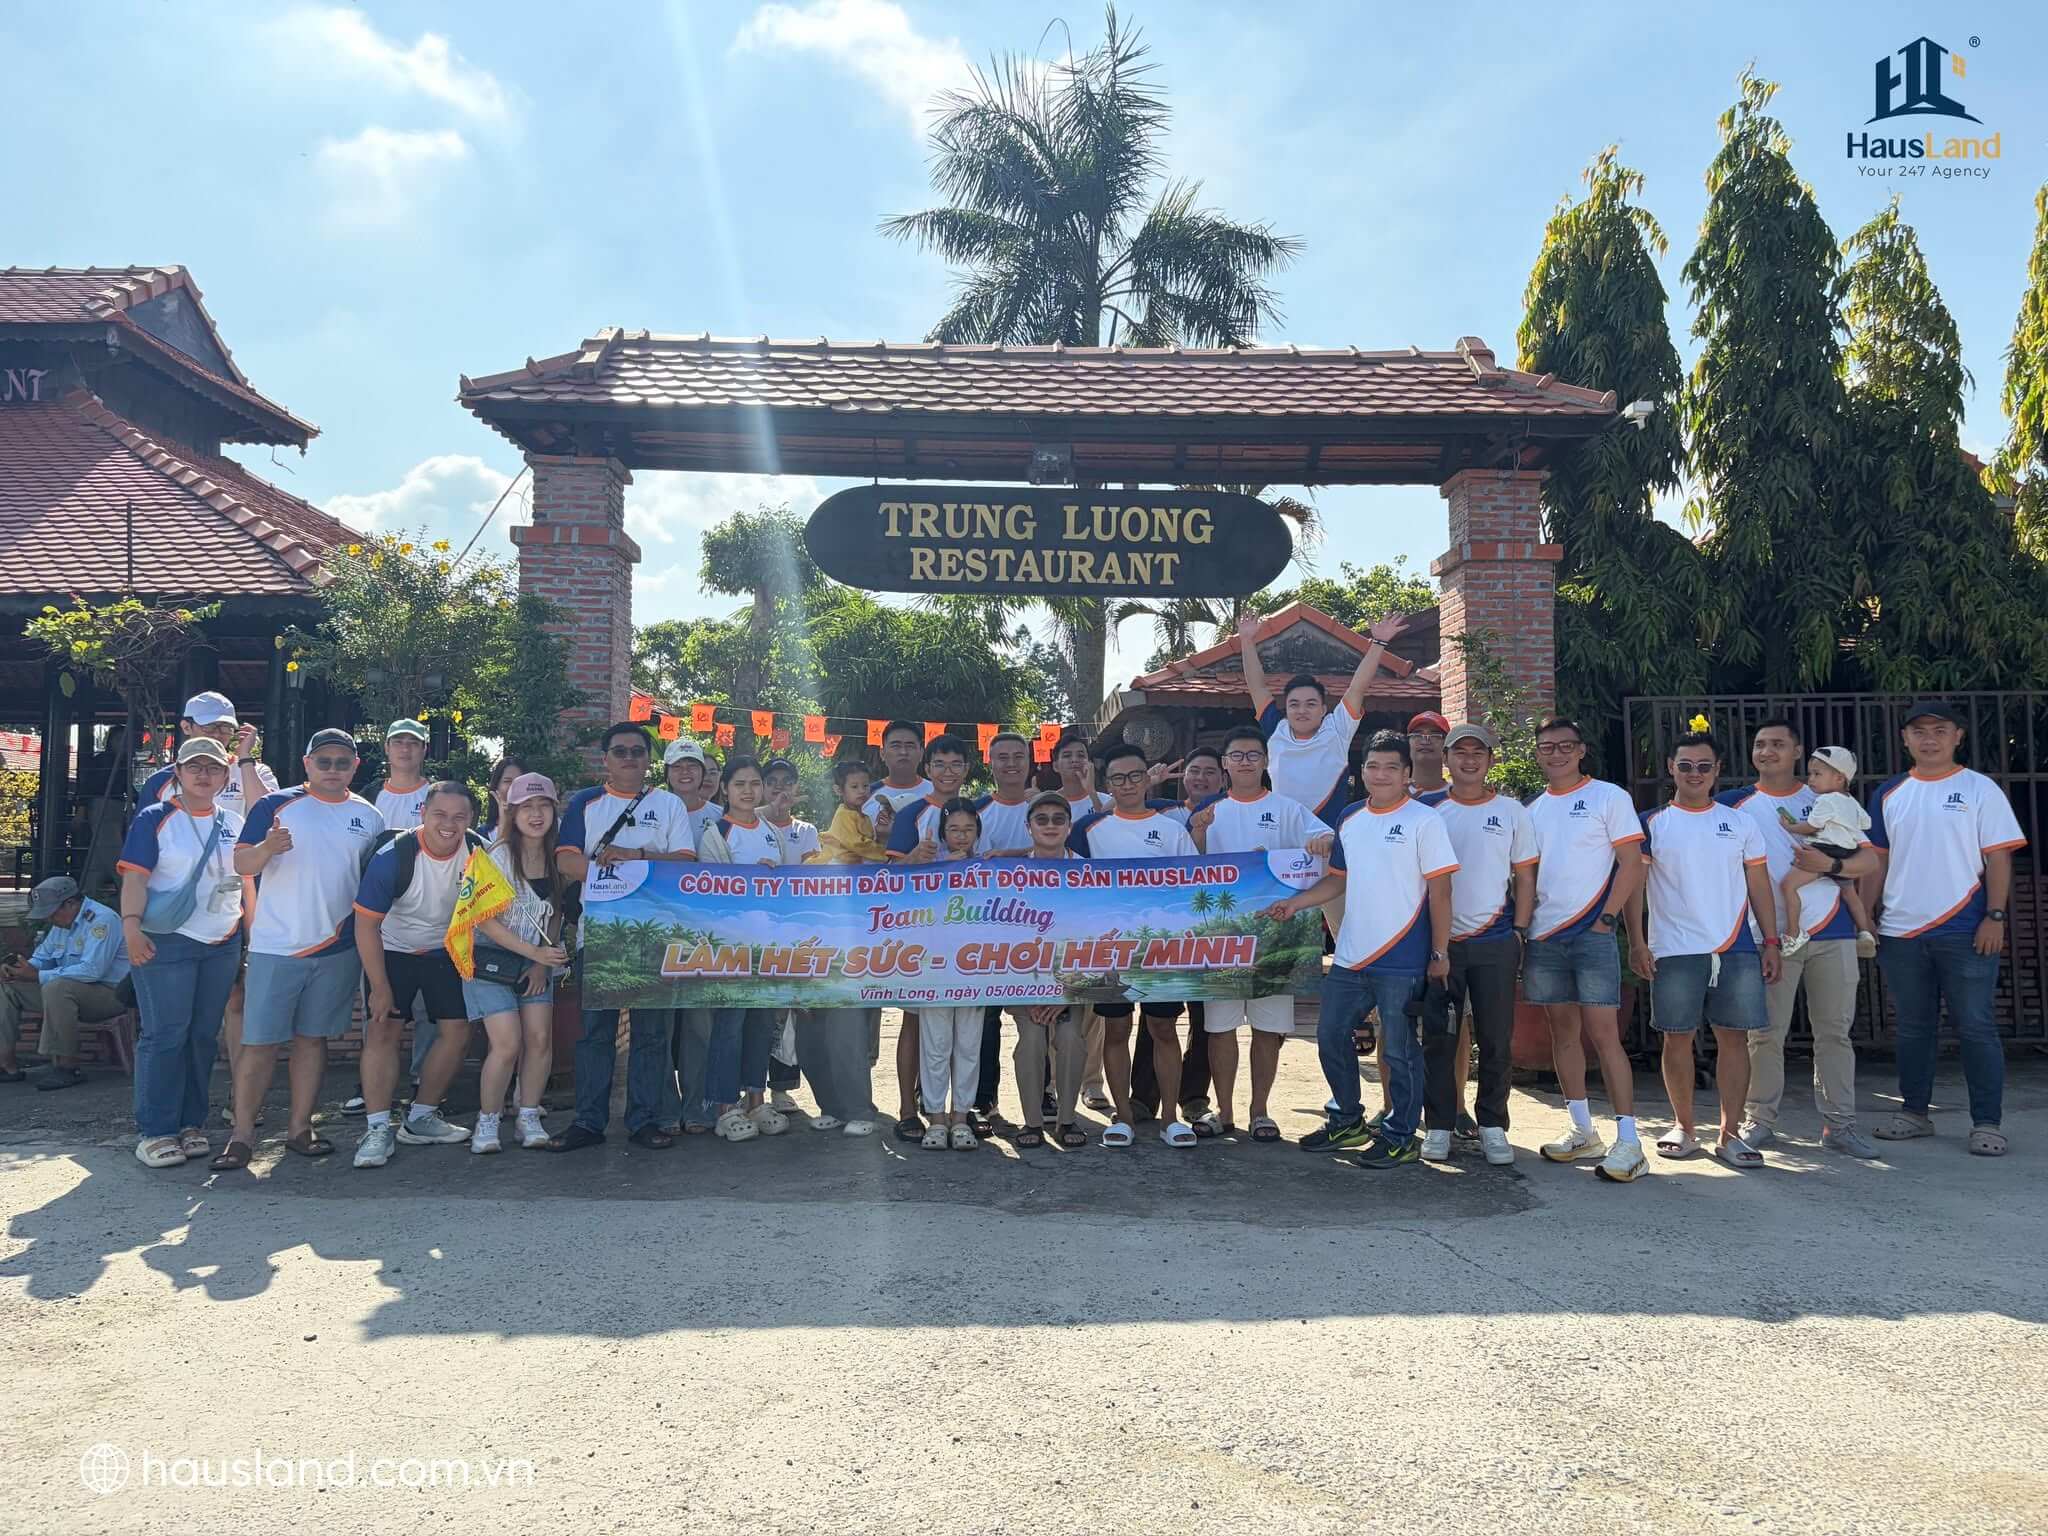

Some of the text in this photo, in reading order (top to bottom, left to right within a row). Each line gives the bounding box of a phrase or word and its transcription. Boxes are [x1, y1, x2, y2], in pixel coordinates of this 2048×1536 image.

[0, 368, 49, 401] NT
[879, 502, 1215, 544] TRUNG LUONG
[910, 547, 1181, 586] RESTAURANT
[680, 864, 1240, 896] CÔNG TY TNHH ĐẦU TƯ BẤT ĐỘNG SẢN HAUSLAND
[868, 896, 1056, 934] Team Building
[661, 937, 752, 978] LÀM
[759, 936, 839, 977] HẾT
[842, 938, 926, 977] SỨC
[955, 936, 1057, 976] CHƠI
[1061, 928, 1138, 972] HẾT
[1141, 931, 1257, 970] MÌNH
[898, 987, 940, 1001] Long,
[945, 985, 981, 1001] ngày
[985, 984, 1064, 998] 05/06/2026
